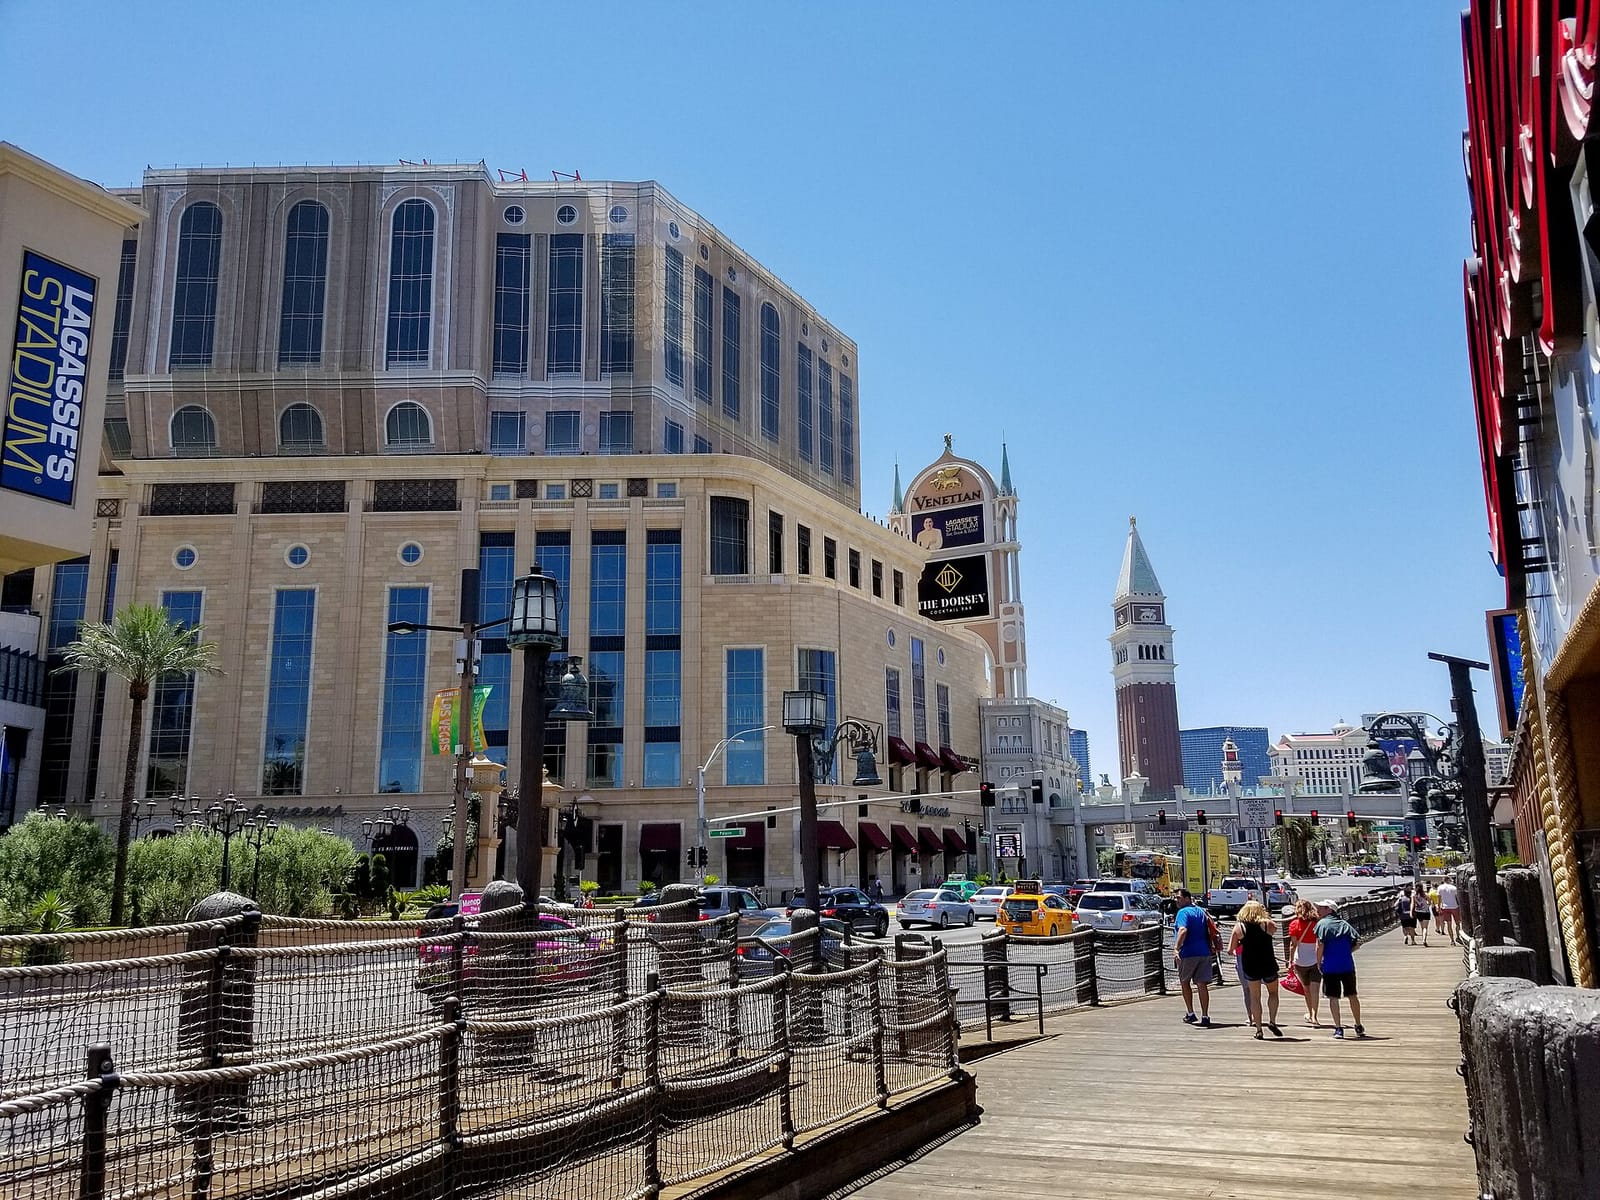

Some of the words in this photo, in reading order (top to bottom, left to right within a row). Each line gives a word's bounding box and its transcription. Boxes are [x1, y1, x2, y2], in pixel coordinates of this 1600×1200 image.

[3, 269, 63, 475] STADIUM
[46, 284, 93, 482] LAGASSE'S
[945, 521, 979, 533] STADIUM
[941, 594, 984, 608] DORSEY
[462, 898, 481, 907] Menop
